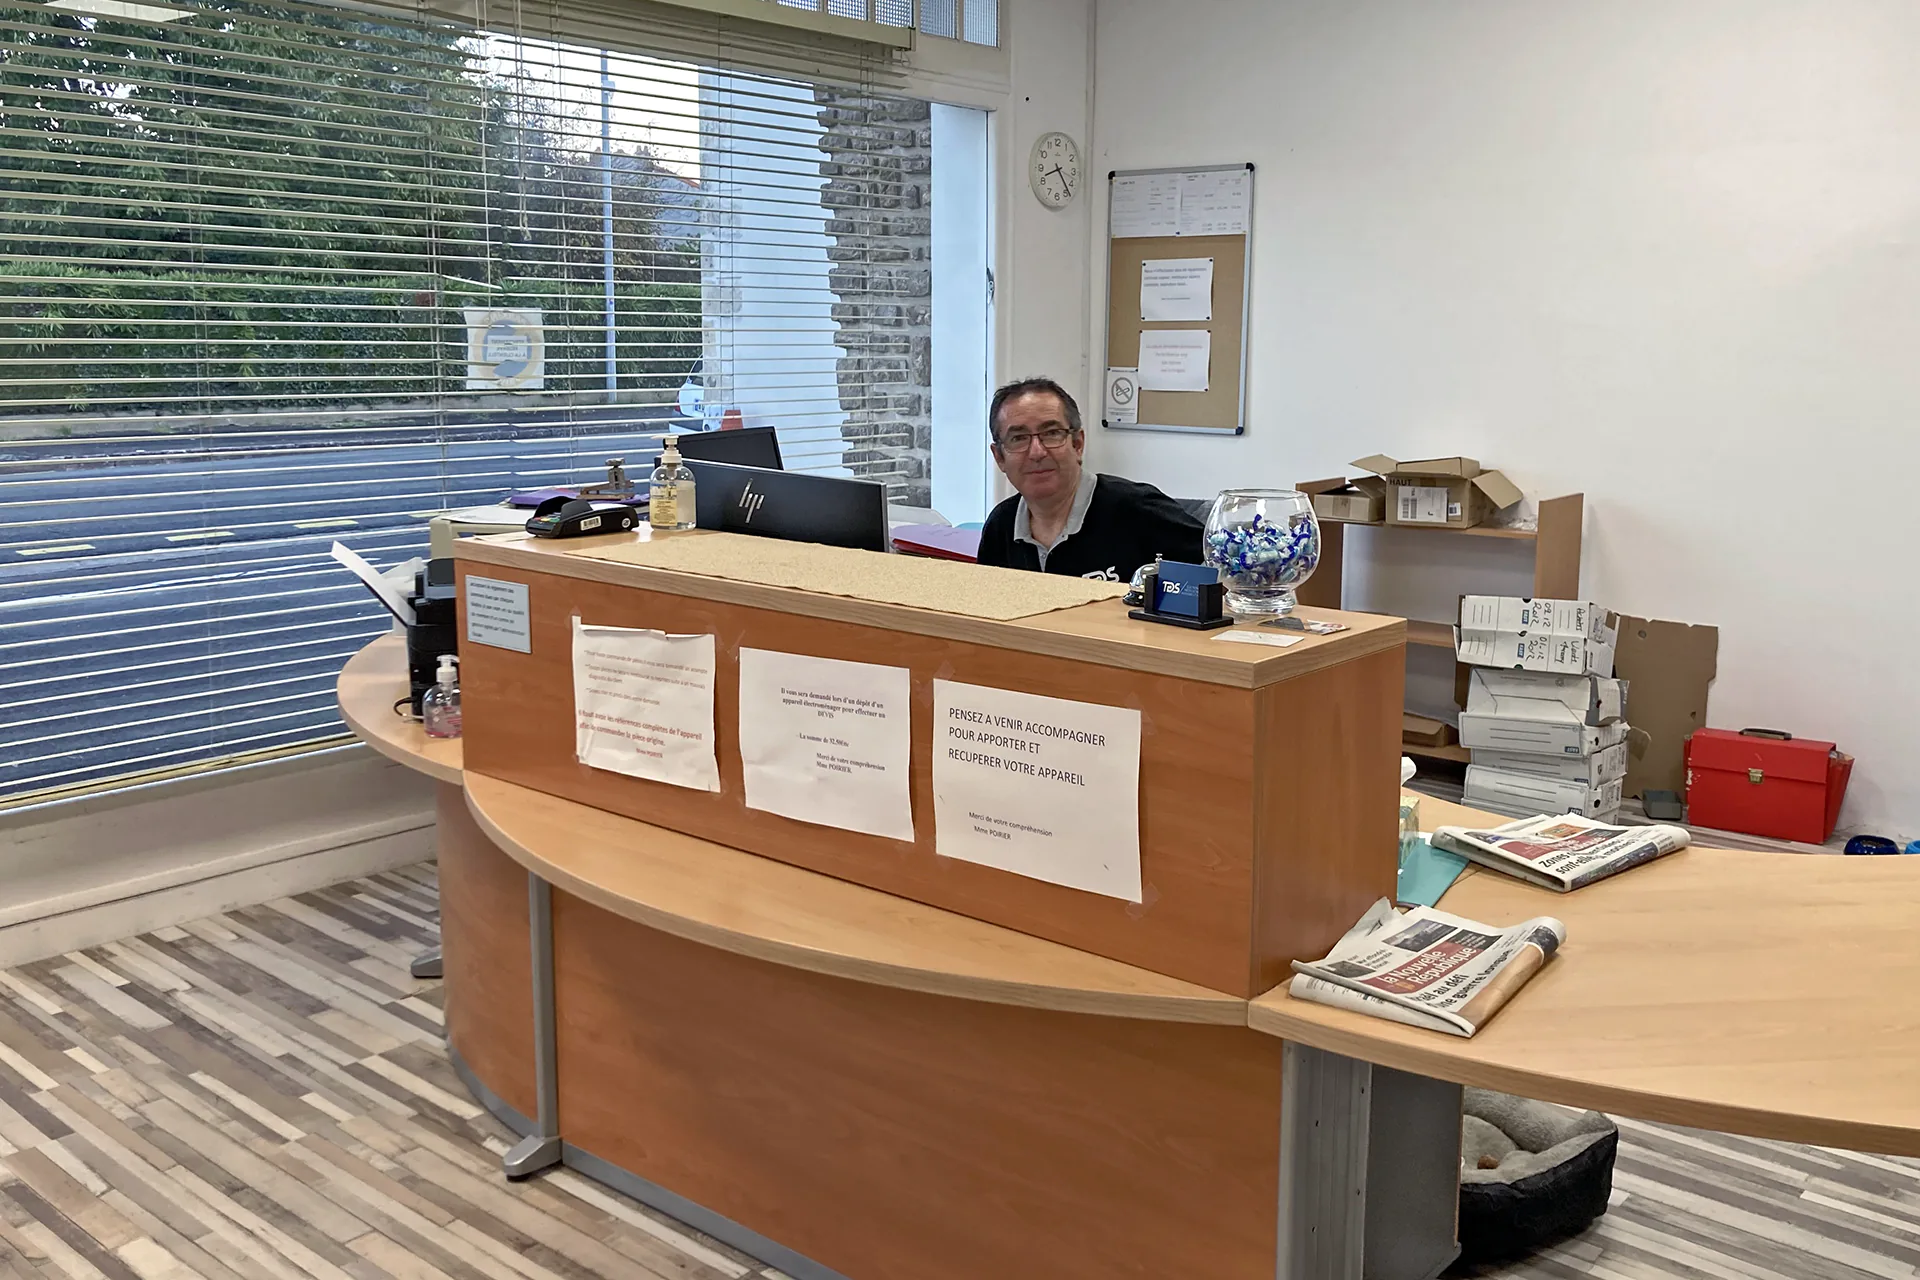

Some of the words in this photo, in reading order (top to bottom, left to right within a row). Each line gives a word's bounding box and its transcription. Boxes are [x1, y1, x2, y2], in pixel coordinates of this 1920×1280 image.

[1162, 581, 1181, 594] TDS
[809, 692, 832, 701] demandé
[832, 695, 842, 703] lors
[782, 698, 803, 706] appareil
[841, 706, 854, 714] pour
[855, 708, 878, 717] effectuer
[949, 708, 983, 724] PENSEZ
[985, 714, 992, 726] A
[994, 715, 1023, 732] VENIR
[1025, 722, 1106, 747] ACCOMPAGNER
[949, 726, 975, 742] POUR
[977, 732, 1026, 752] APPORTER
[1029, 742, 1041, 754] ET
[816, 752, 829, 760] Merci
[837, 757, 849, 765] votre
[948, 748, 1001, 768] RECUPERER
[1003, 758, 1035, 776] VOTRE
[1037, 766, 1086, 787] APPAREIL
[969, 811, 984, 821] Merci
[985, 815, 992, 823] de
[993, 818, 1008, 827] votre
[1009, 821, 1053, 837] compréhension
[974, 825, 988, 835] Mme
[989, 828, 1012, 841] POIRIER
[1538, 853, 1571, 868] Zones
[1378, 974, 1398, 985] la
[1391, 949, 1447, 980] Nouvelle
[1406, 945, 1478, 985] République
[1433, 985, 1451, 996] au
